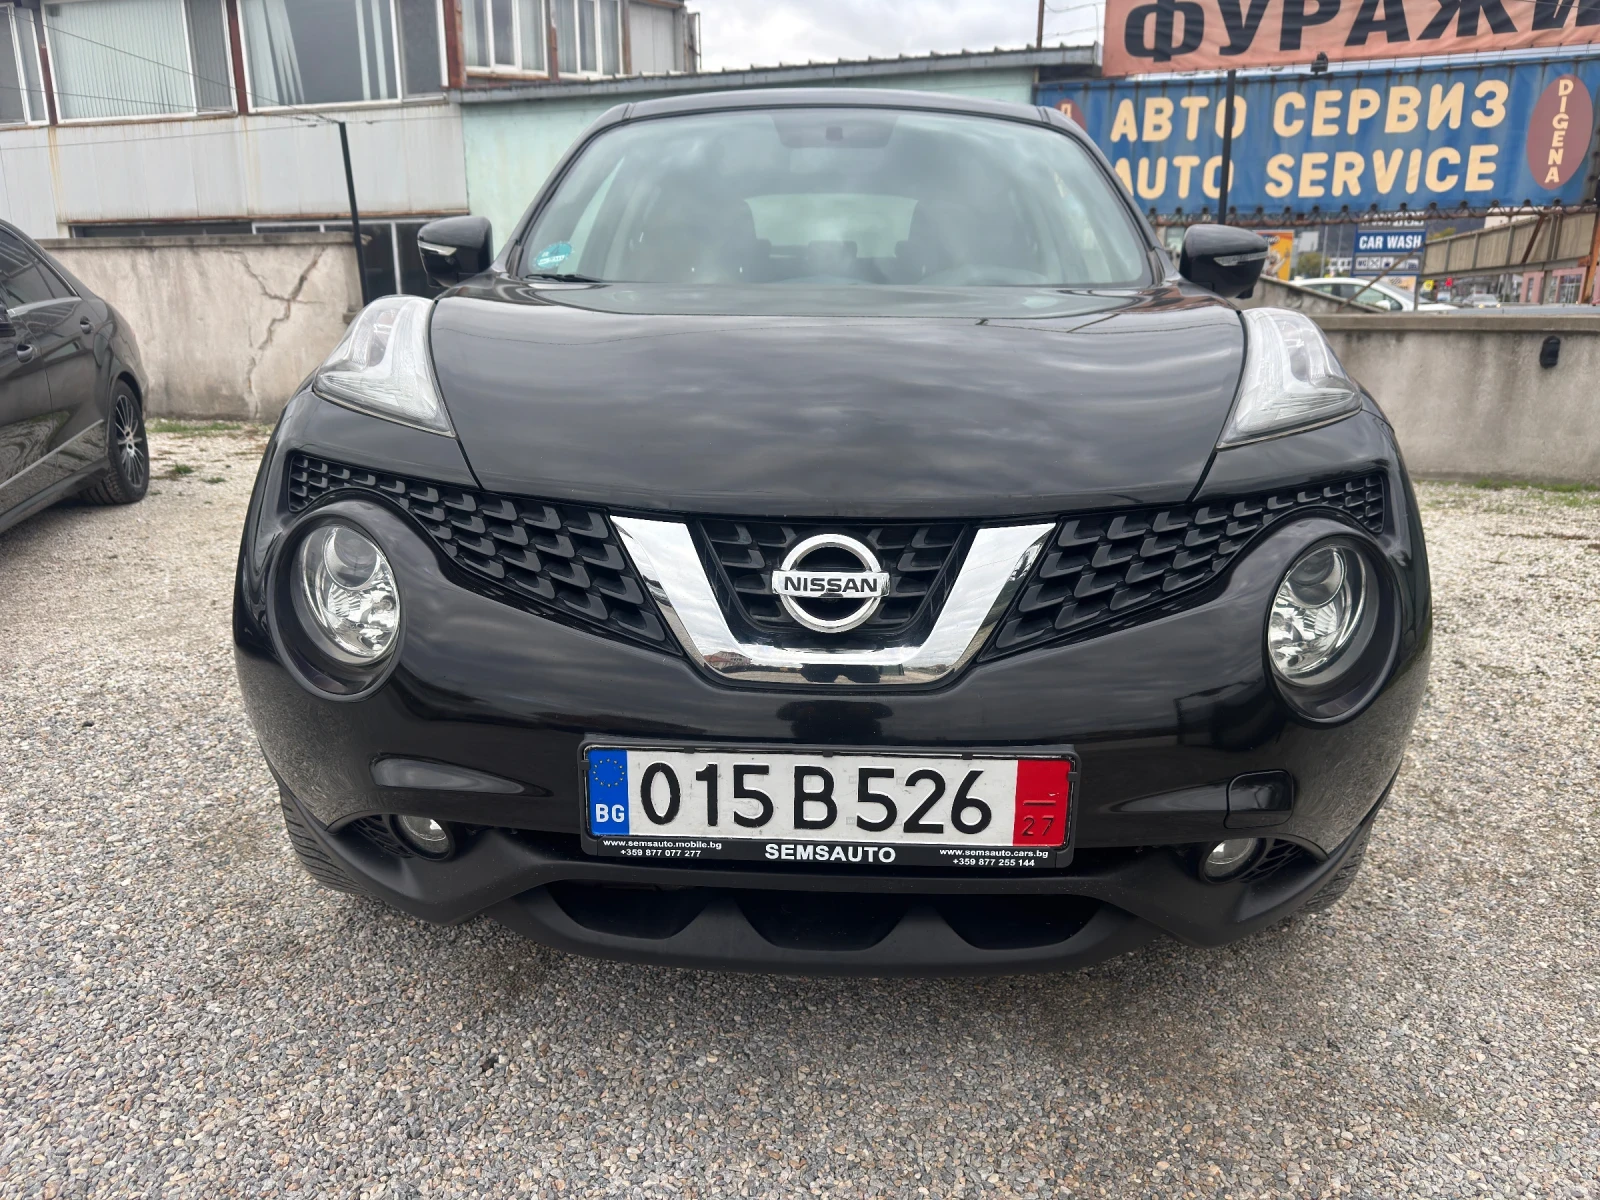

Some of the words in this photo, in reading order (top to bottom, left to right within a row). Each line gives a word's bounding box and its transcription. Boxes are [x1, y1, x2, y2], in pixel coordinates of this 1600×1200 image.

[1110, 95, 1247, 143] АВТО
[1273, 79, 1509, 138] СЕРВИЗ
[1544, 79, 1574, 183] DIGENA
[1114, 155, 1234, 199] AUTO
[1265, 144, 1499, 198] SERVICE
[1359, 235, 1384, 250] CAR
[1387, 234, 1422, 249] WASH
[784, 576, 878, 593] NISSAN
[595, 803, 625, 823] BG
[1021, 815, 1055, 837] 27
[602, 839, 722, 850] www.semsauto.mobile.bg
[620, 848, 643, 857] +359
[645, 848, 662, 857] 877
[664, 849, 682, 858] 077
[684, 850, 702, 858] 277
[764, 843, 896, 864] SEMSAUTO
[939, 848, 1049, 859] www.semsauto.cars.bg
[952, 858, 976, 867] +359
[978, 858, 996, 867] 877
[998, 859, 1016, 867] 255
[1018, 859, 1035, 868] 144
